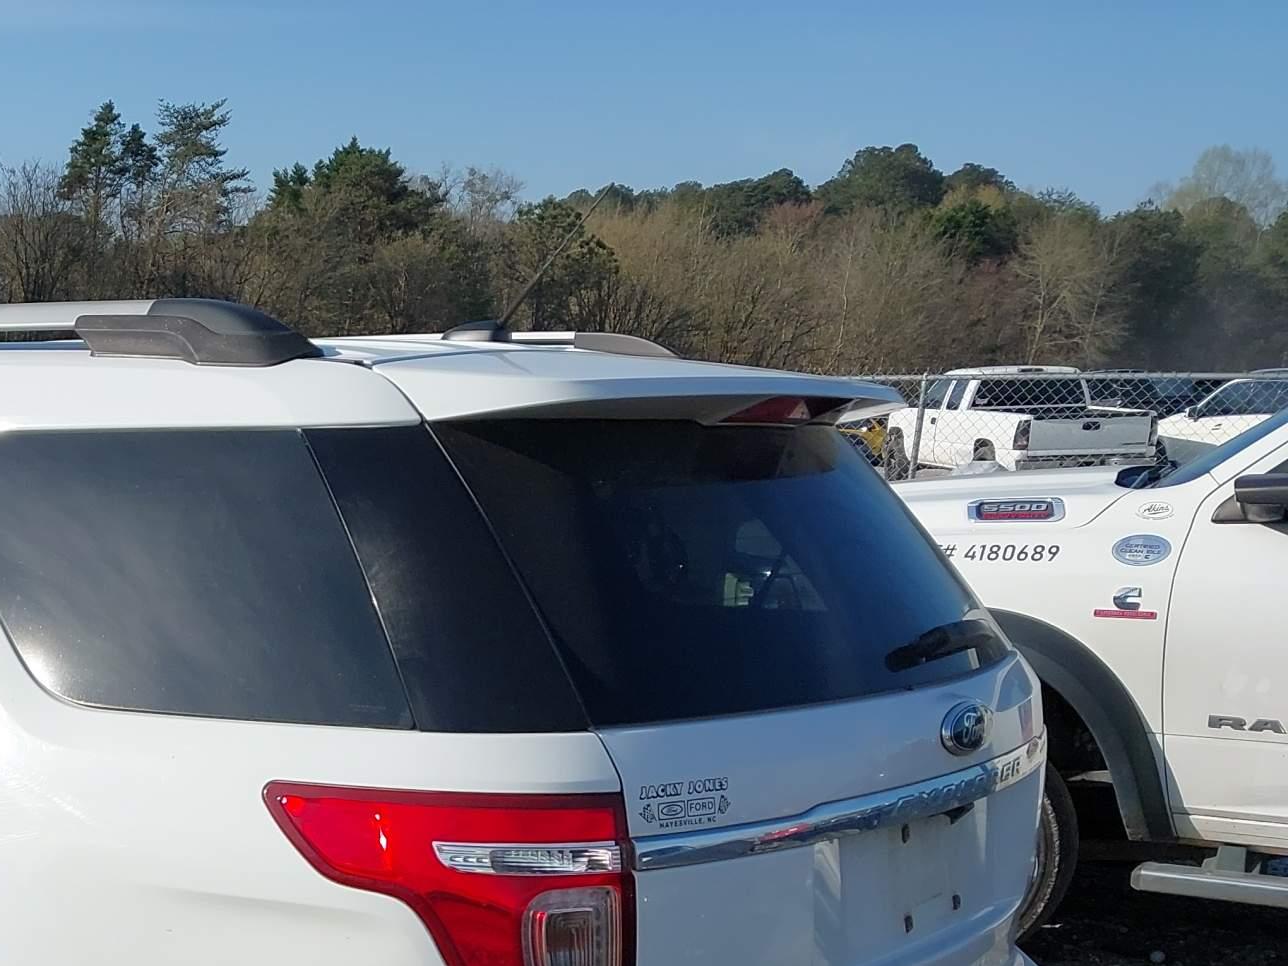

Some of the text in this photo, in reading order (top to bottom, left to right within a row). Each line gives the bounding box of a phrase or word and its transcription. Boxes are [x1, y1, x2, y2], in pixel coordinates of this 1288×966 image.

[982, 503, 1049, 512] 5500
[964, 544, 1061, 562] 4180689
[639, 777, 729, 800] JACKY JONES
[689, 801, 714, 812] FORD
